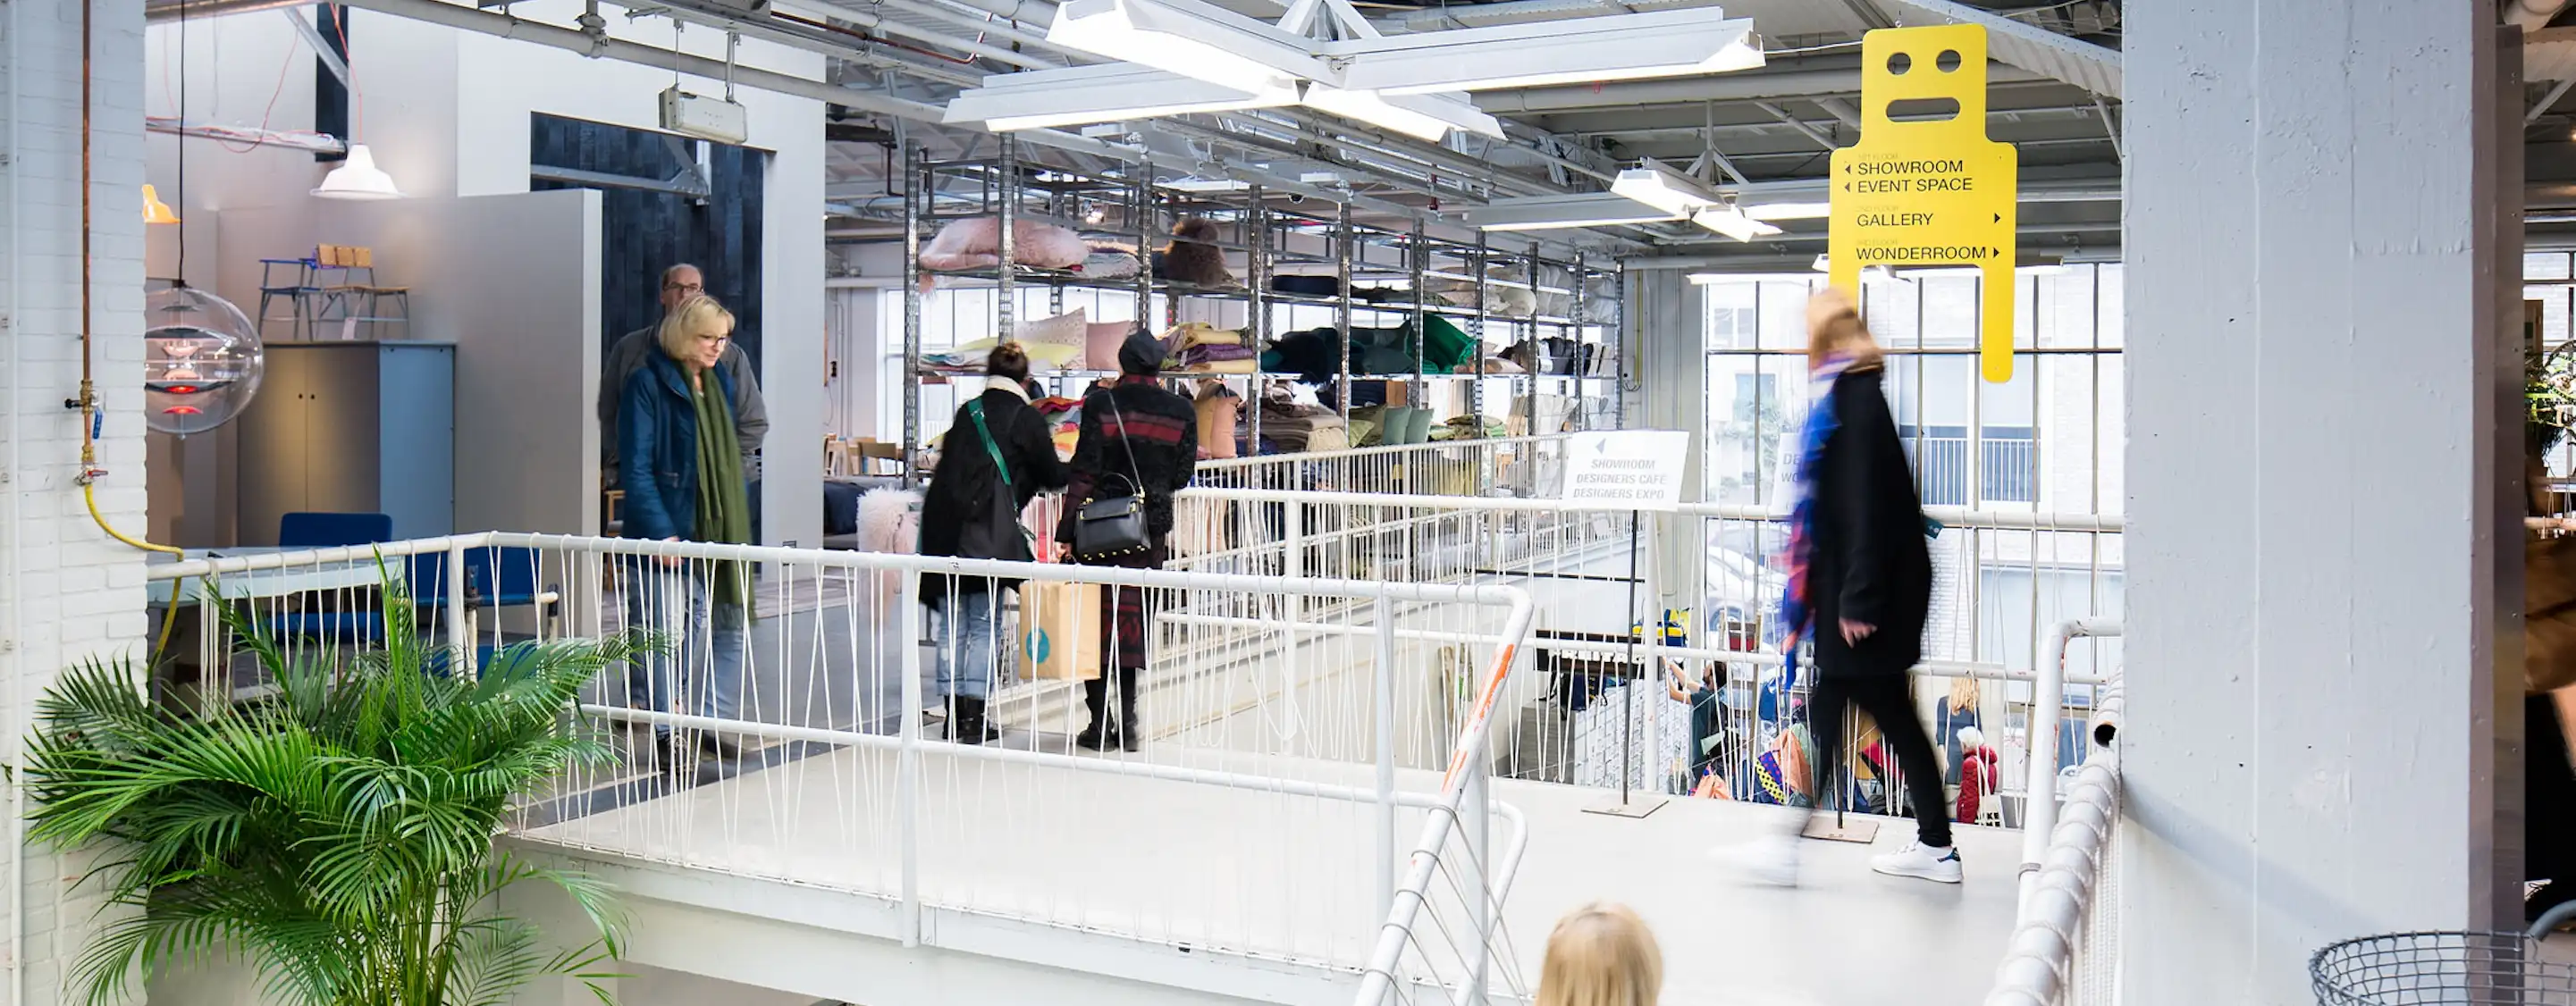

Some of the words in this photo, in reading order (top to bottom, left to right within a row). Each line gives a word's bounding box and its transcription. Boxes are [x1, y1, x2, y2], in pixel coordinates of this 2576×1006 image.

[1857, 160, 1963, 175] SHOWROOM
[1857, 180, 1911, 193] EVENT
[1916, 178, 1973, 191] SPACE
[1856, 213, 1933, 227] GALLERY
[1856, 246, 1986, 260] WONDERROOM
[1591, 458, 1655, 470] SHOWROOM
[1576, 473, 1636, 484] DESIGNERS
[1573, 487, 1633, 499] DESIGNERS
[1636, 488, 1664, 499] EXPO
